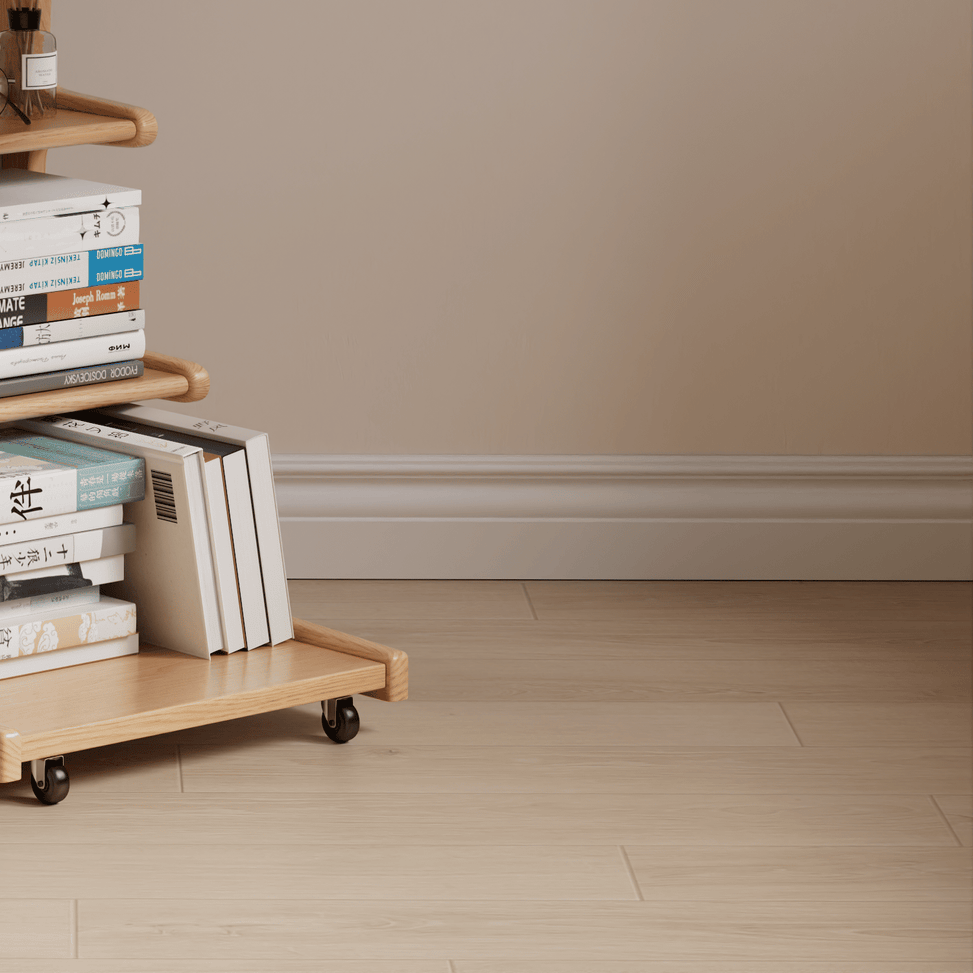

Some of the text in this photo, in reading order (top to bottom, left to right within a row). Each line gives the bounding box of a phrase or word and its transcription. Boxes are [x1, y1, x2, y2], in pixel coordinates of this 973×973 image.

[0, 261, 25, 272] JEREMY
[0, 283, 25, 294] JEREMY
[72, 289, 94, 306] Joseph
[95, 288, 116, 302] Romm
[108, 343, 131, 351] МИФ
[63, 365, 138, 385] FYODOR DOSTOEVSKY
